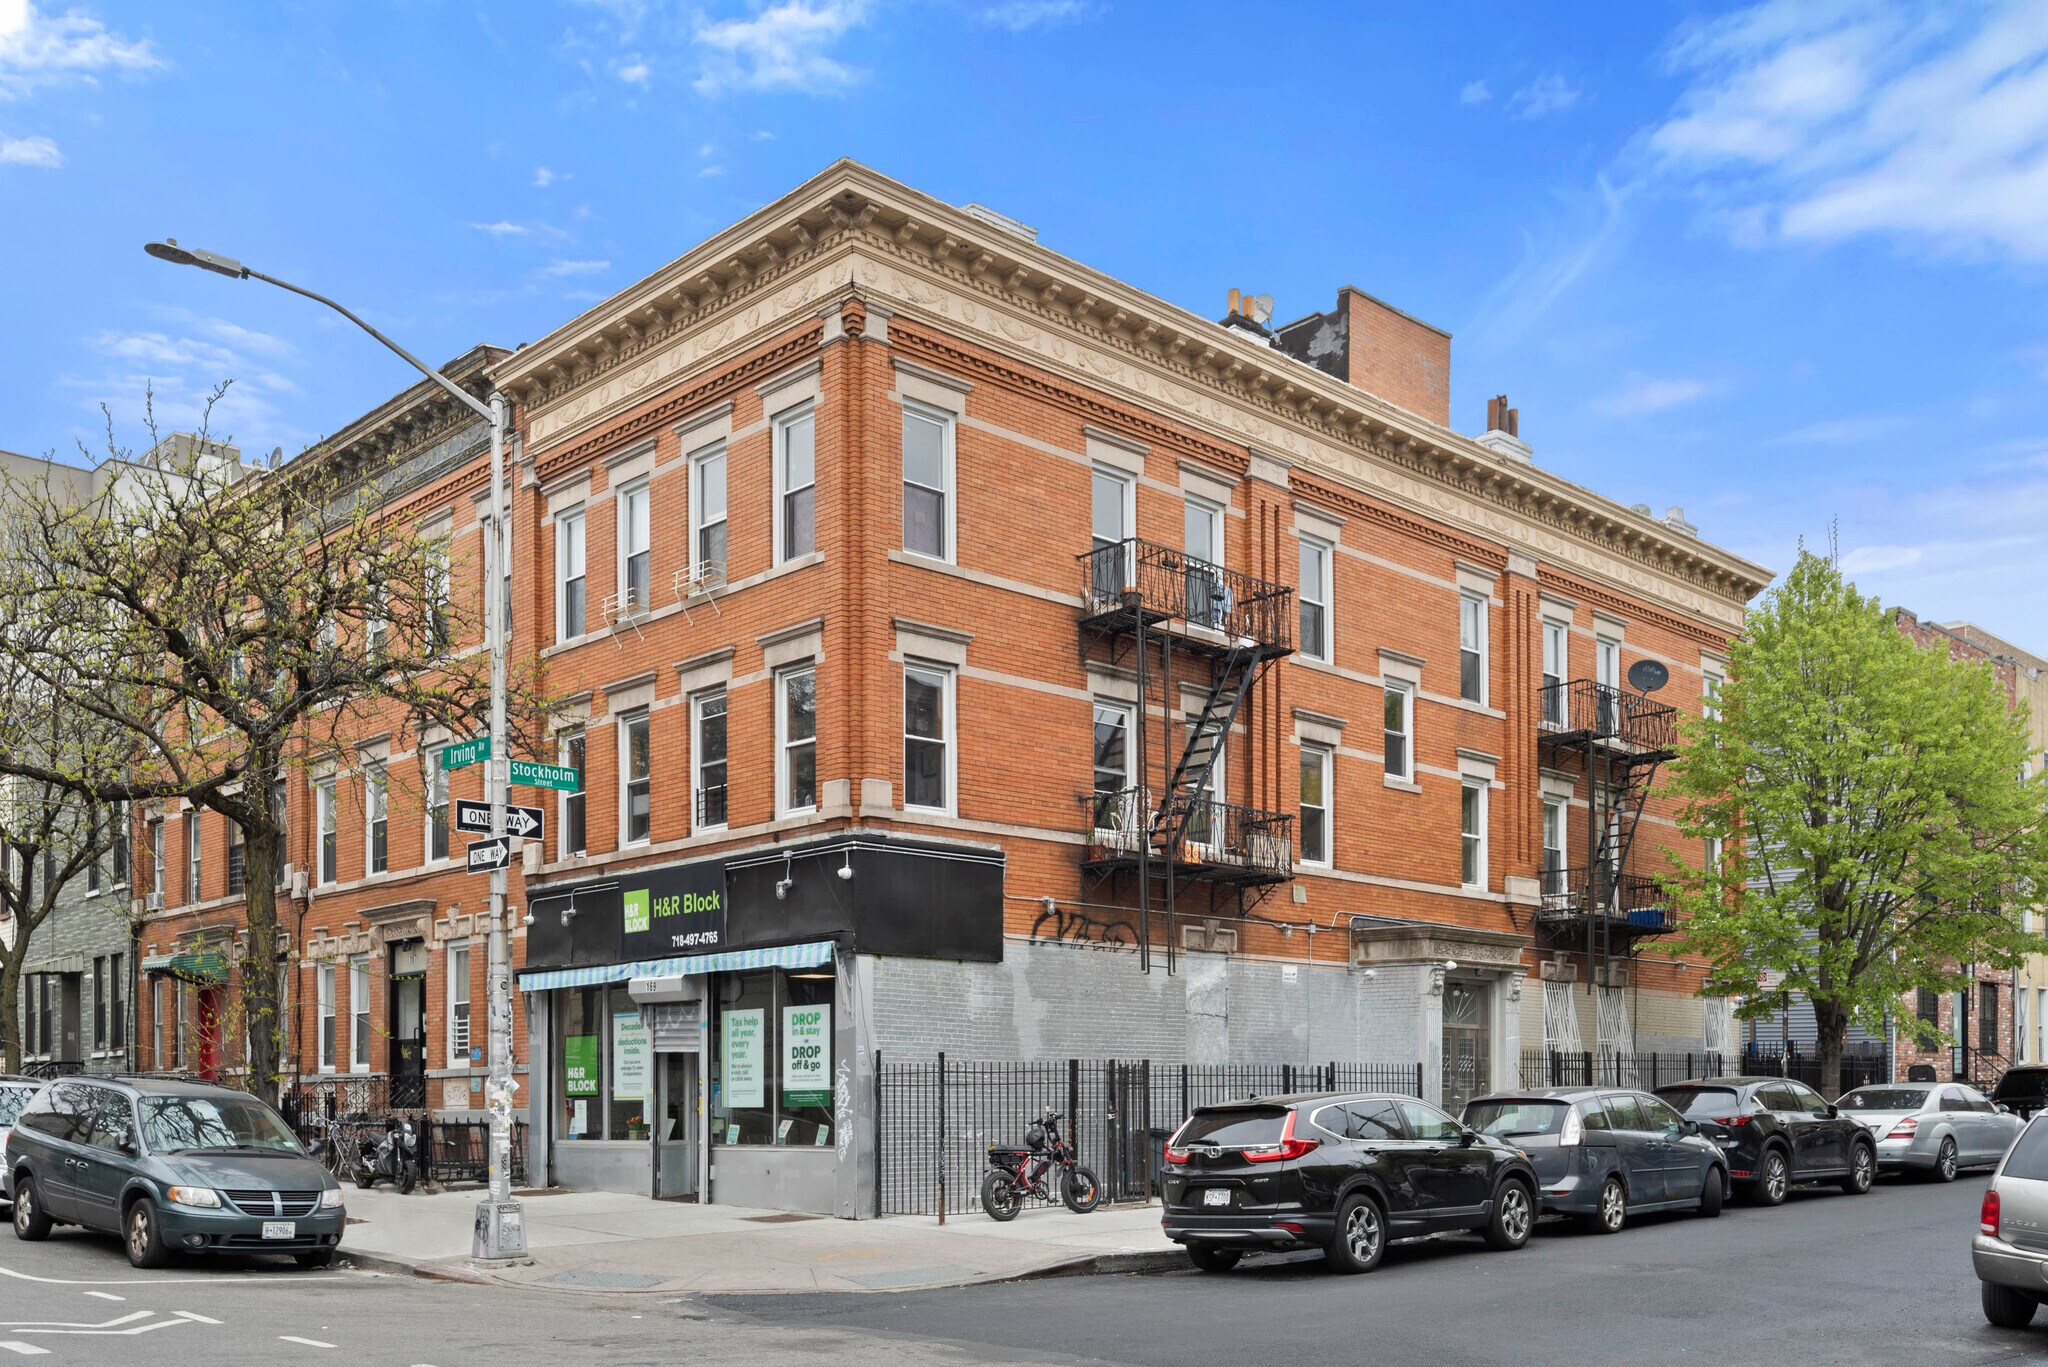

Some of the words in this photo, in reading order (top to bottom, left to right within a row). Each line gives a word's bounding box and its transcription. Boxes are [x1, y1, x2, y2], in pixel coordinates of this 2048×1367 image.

[450, 745, 476, 764] Irving
[512, 763, 574, 782] Stockholm
[534, 778, 553, 787] Street
[469, 811, 491, 825] ONE
[507, 816, 530, 829] WAY
[473, 850, 485, 864] ONE
[490, 847, 504, 860] WAY
[625, 903, 639, 918] H&R
[653, 895, 680, 918] H&R
[683, 889, 720, 914] Block
[625, 917, 648, 931] BLOCK
[671, 931, 718, 948] 718-497-4765
[731, 1017, 742, 1027] Tax
[743, 1016, 759, 1028] help
[792, 1012, 821, 1026] DROP
[731, 1028, 740, 1038] all
[740, 1029, 756, 1039] year,
[792, 1026, 798, 1036] in
[799, 1026, 805, 1035] &
[806, 1026, 820, 1036] stay
[618, 1037, 648, 1046] deductions
[731, 1040, 750, 1050] every
[792, 1045, 821, 1059] DROP
[568, 1067, 585, 1079] H&R
[792, 1060, 802, 1070] off
[803, 1060, 810, 1070] &
[810, 1061, 821, 1072] go
[568, 1080, 596, 1092] BLOCK
